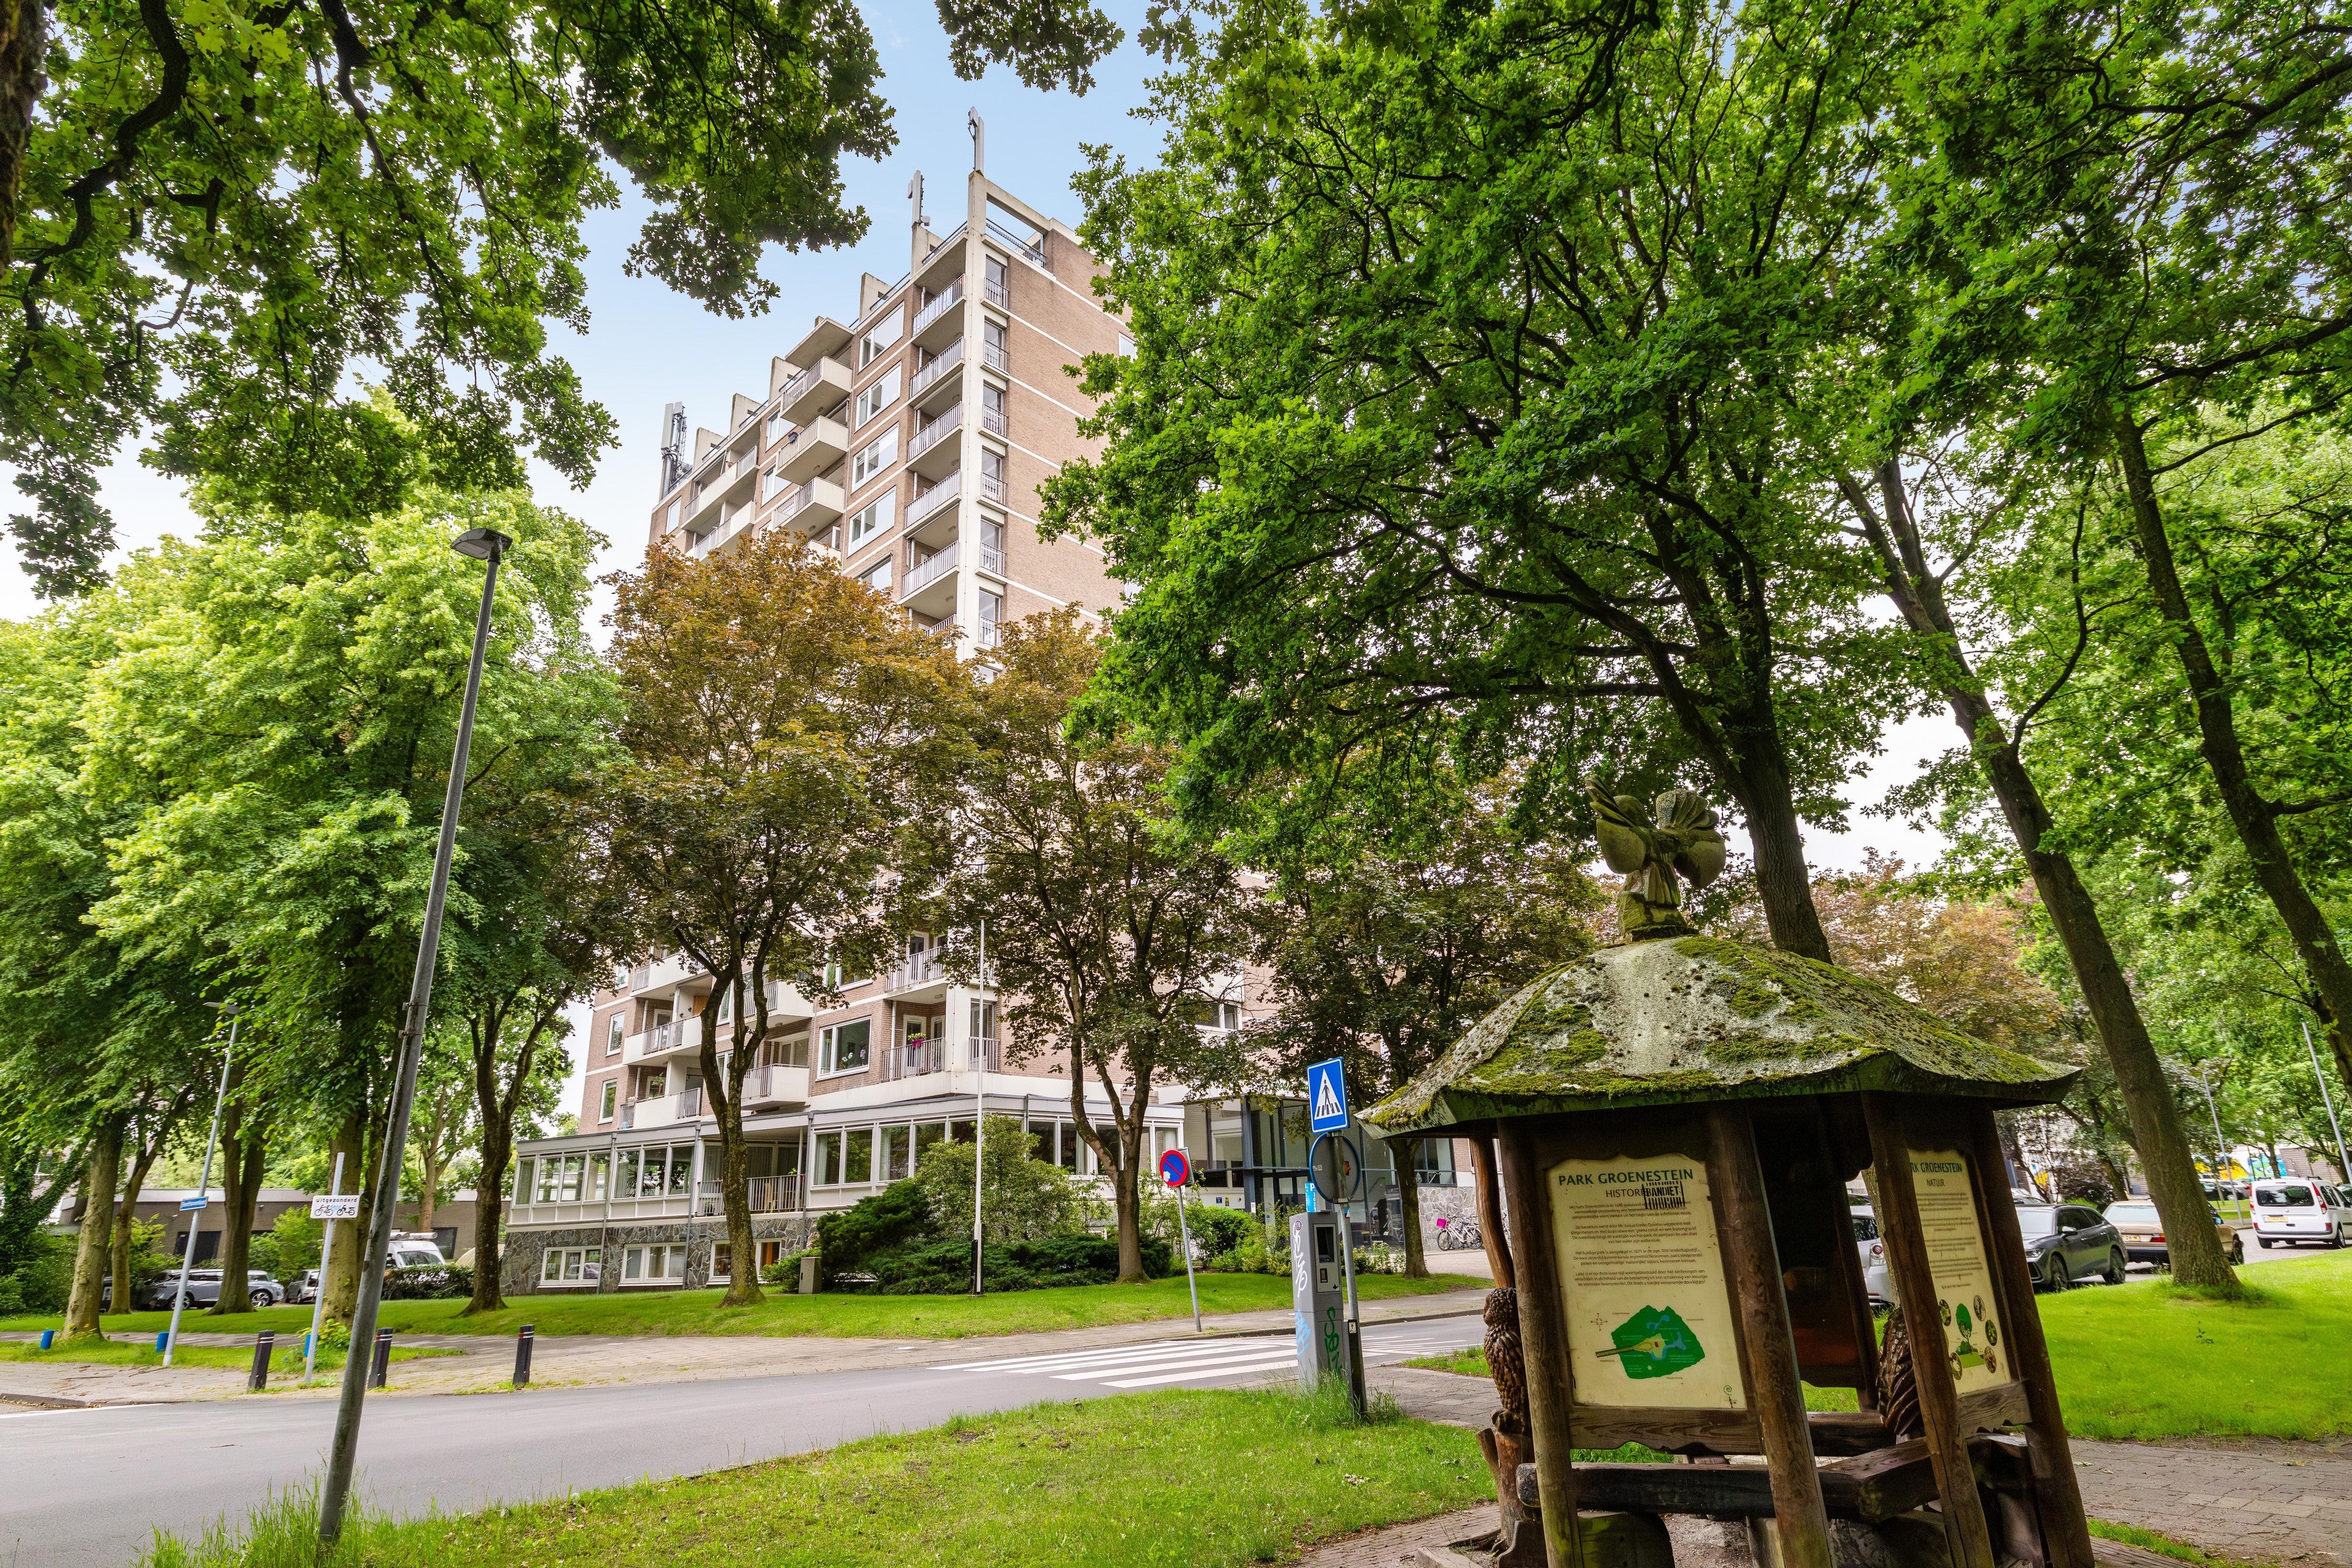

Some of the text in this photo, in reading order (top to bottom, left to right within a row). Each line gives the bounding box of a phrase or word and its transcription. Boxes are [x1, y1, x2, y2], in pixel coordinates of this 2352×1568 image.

[1911, 1163, 1962, 1173] RK GROENESTEIN
[1558, 1169, 1694, 1186] PARK GROENESTEIN
[1310, 1183, 1315, 1191] P
[1647, 1186, 1679, 1197] BANDIET
